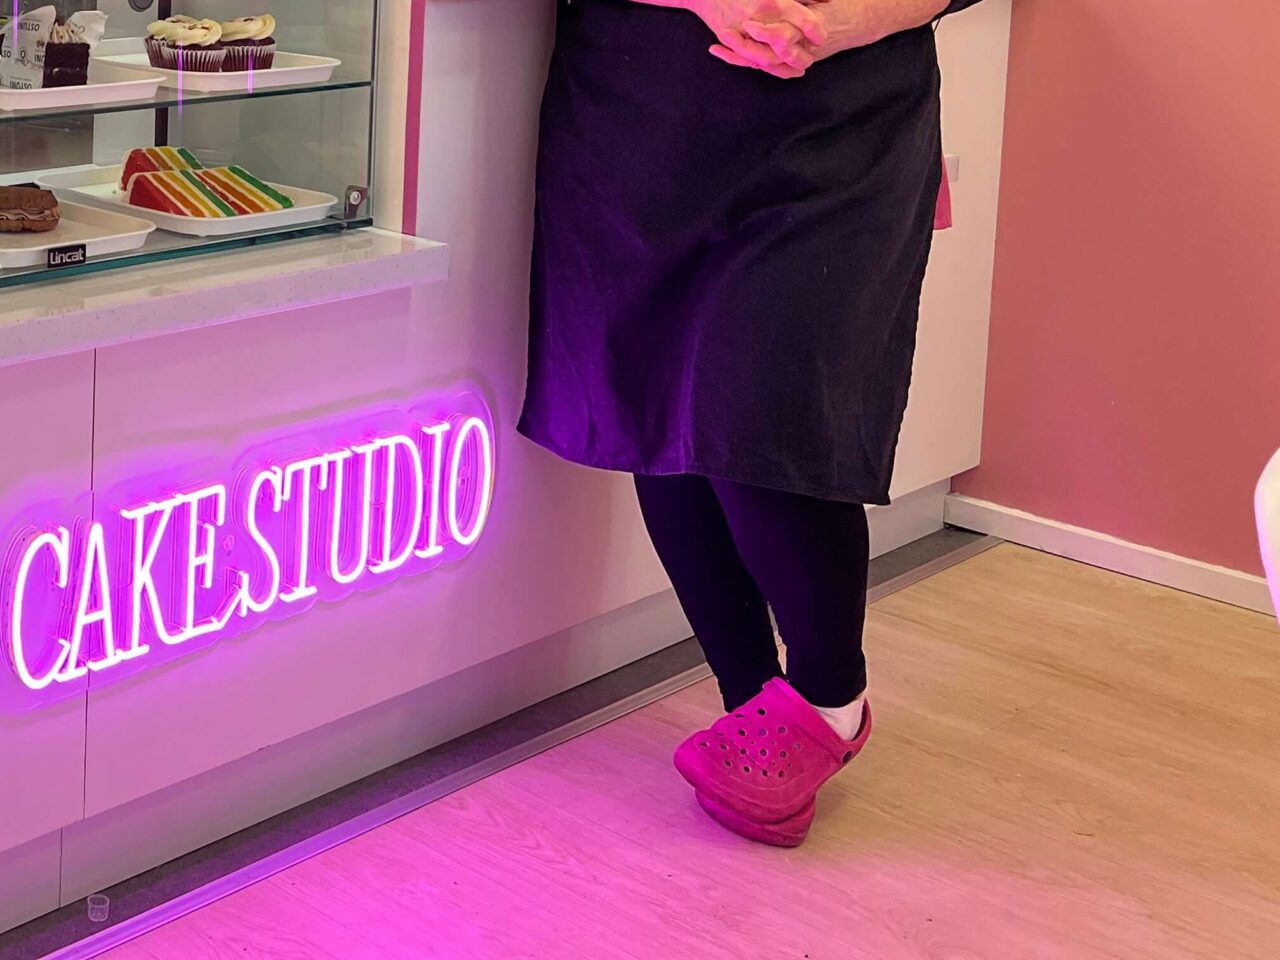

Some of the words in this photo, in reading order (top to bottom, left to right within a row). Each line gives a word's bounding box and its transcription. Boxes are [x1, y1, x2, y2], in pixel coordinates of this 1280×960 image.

[50, 248, 84, 264] Lincat
[7, 482, 247, 694] CAKE
[238, 414, 494, 616] STUDIO
